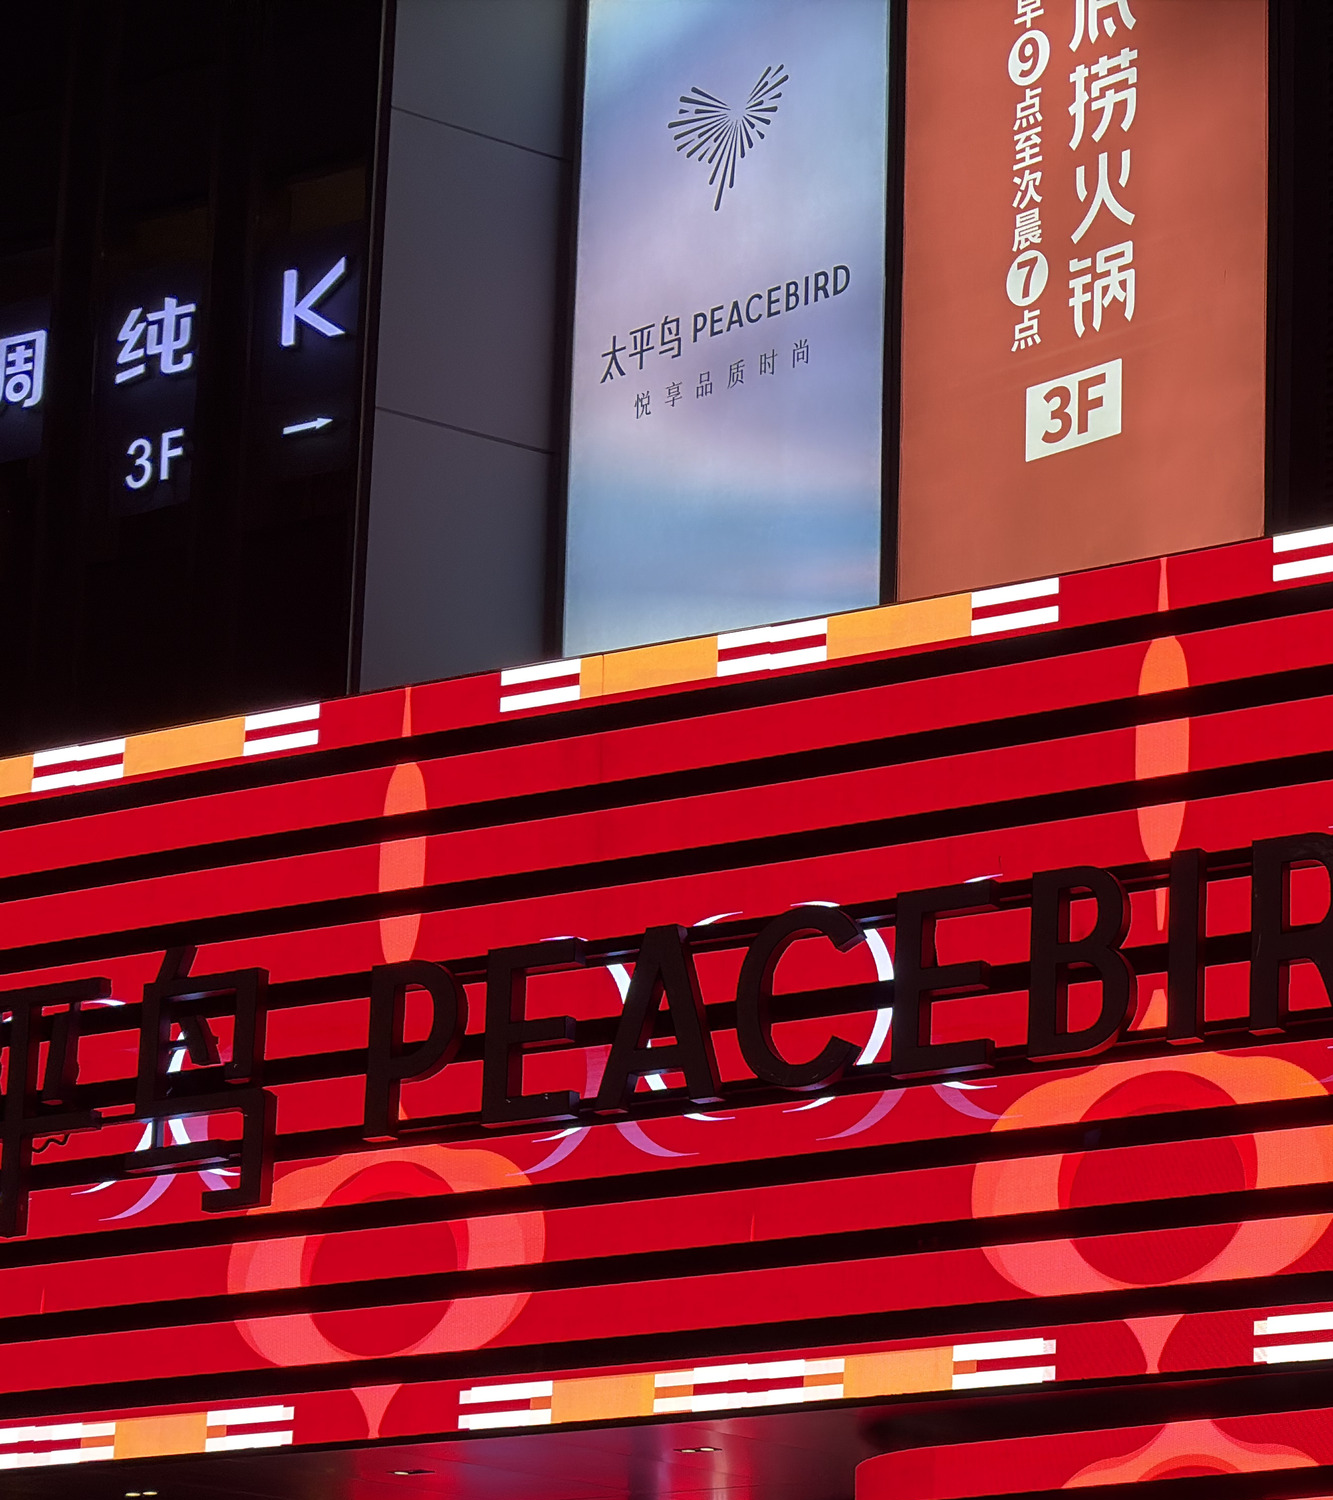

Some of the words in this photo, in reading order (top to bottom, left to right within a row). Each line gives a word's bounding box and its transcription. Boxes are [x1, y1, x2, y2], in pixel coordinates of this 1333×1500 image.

[600, 315, 683, 385] 太平鸟
[691, 264, 851, 344] PEACEBIRD
[634, 338, 810, 420] 悦享品质时尚
[1040, 370, 1108, 445] 3F
[125, 428, 185, 490] 3F
